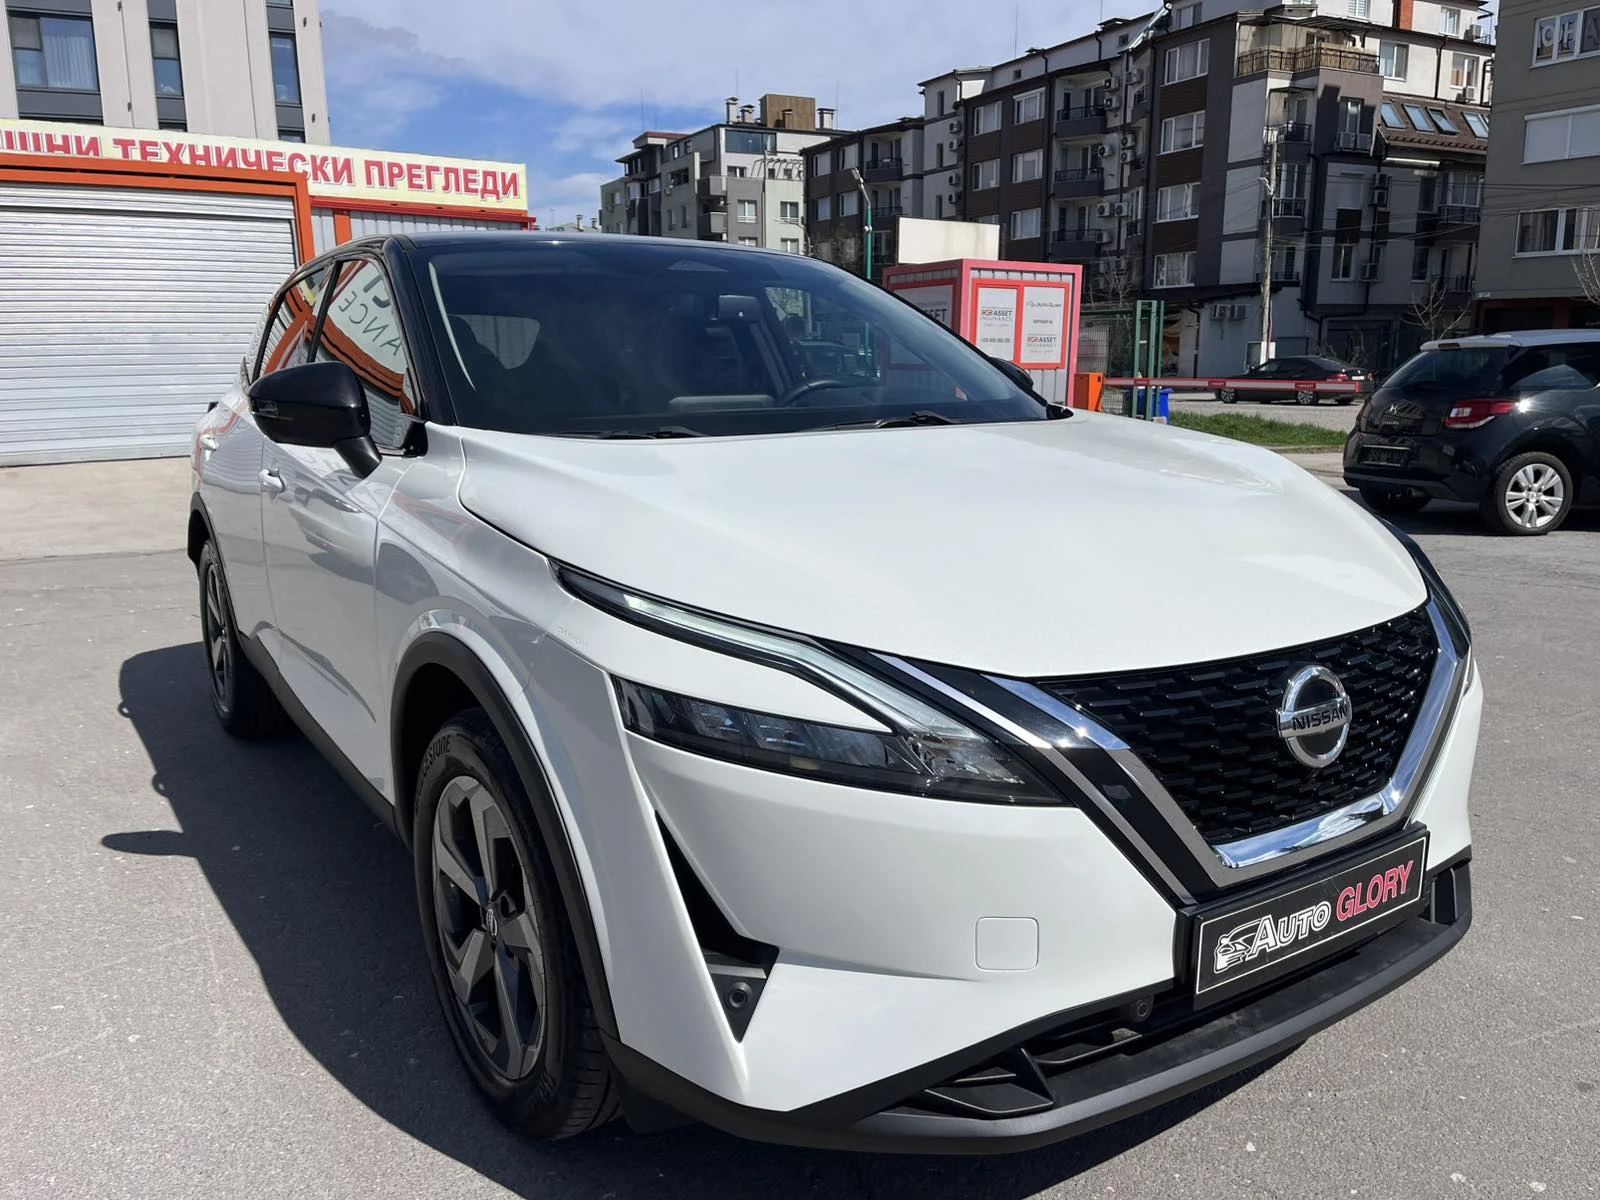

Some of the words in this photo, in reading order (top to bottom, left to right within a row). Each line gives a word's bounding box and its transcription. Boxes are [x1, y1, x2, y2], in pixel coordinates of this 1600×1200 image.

[113, 138, 355, 185] ТЕХНИЧЕСКИ
[364, 159, 519, 201] ПРЕГЛЕДИ
[993, 309, 1013, 317] ASSET
[1292, 704, 1348, 731] NISSAN
[1245, 901, 1332, 961] AUTO
[1336, 860, 1415, 922] GLORY
